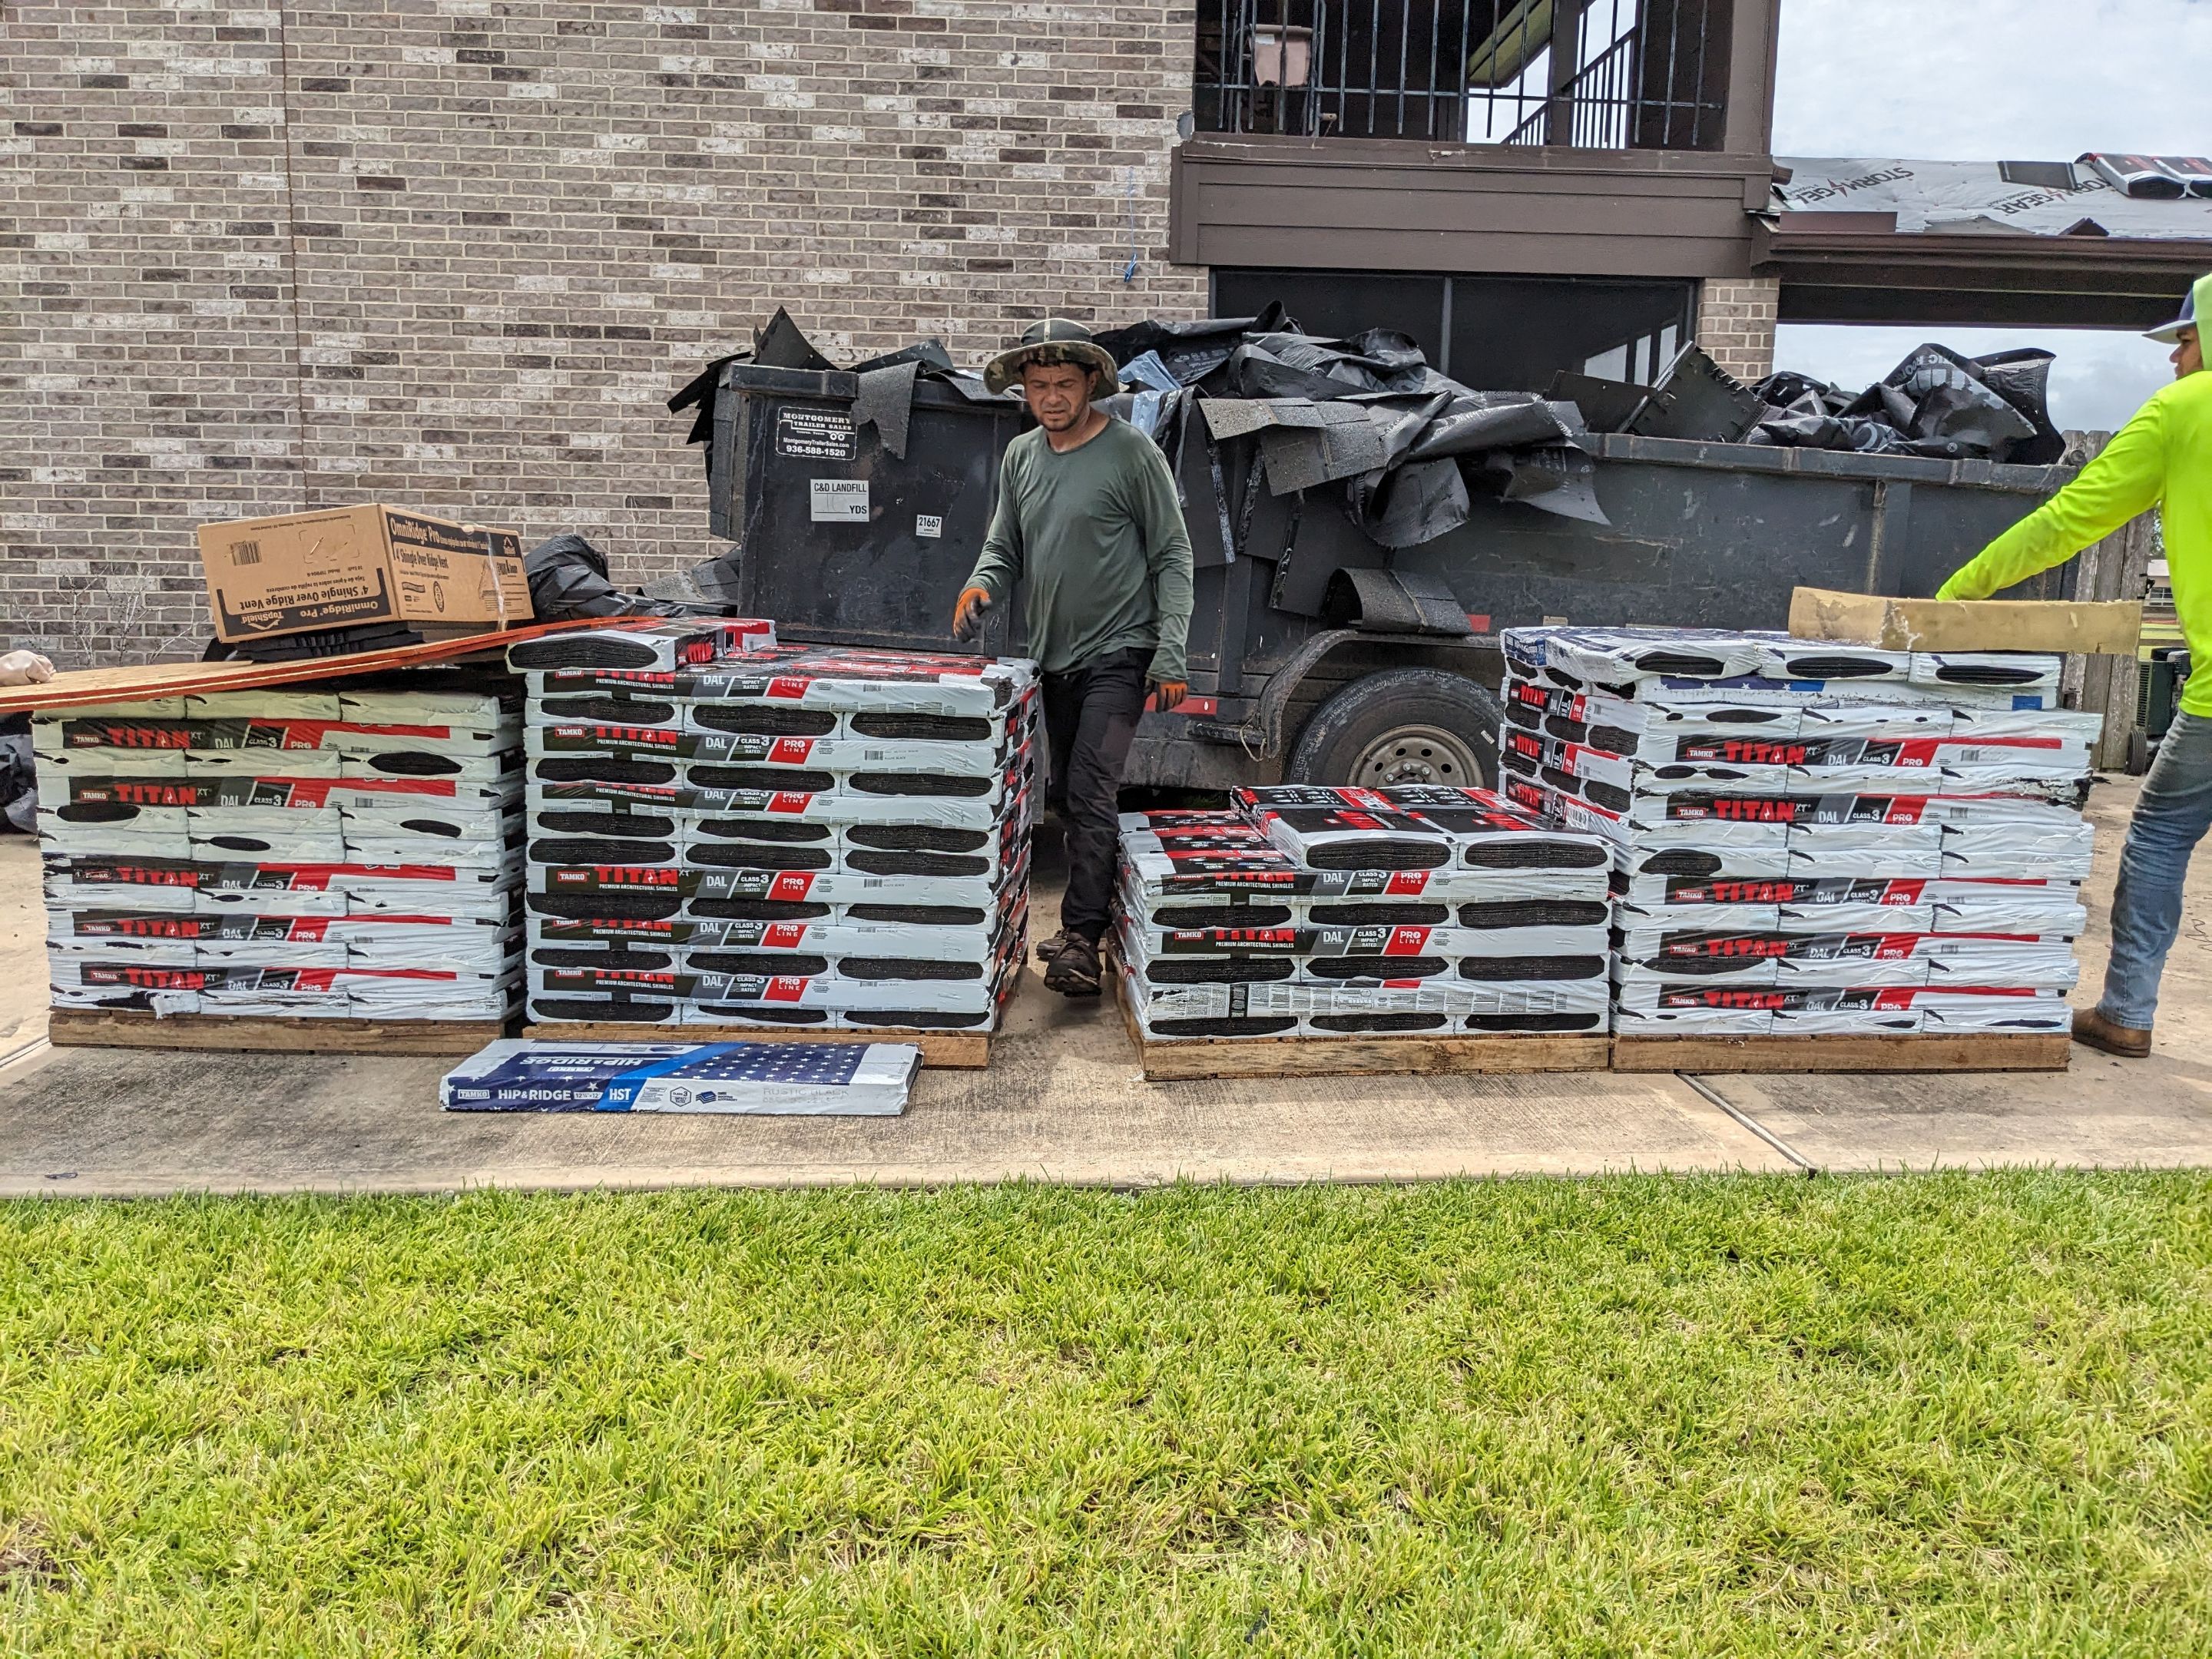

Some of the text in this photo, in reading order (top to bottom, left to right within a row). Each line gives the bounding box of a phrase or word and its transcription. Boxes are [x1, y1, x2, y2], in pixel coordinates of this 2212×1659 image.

[1841, 167, 1914, 190] STORM
[1993, 194, 2055, 214] GEAR
[783, 412, 851, 424] MONTGOMERY
[783, 437, 849, 448] MontgomeryTrailerSales.com
[786, 445, 846, 457] 936-588-1520
[814, 482, 867, 492] C&D LANDFILL
[849, 505, 867, 515] YDS
[919, 516, 941, 528] 21667
[428, 525, 440, 544] Pro
[296, 592, 320, 602] Over
[321, 586, 359, 598] Shingle
[266, 594, 295, 606] Ridge
[240, 601, 264, 611] Vent
[242, 611, 284, 624] TopShield
[300, 609, 318, 618] Pro
[618, 680, 652, 689] ARCHITECTURAL
[703, 675, 725, 685] DAL
[1521, 684, 1545, 707] TITAN
[107, 728, 190, 749] TITAN
[268, 737, 277, 747] 3
[705, 737, 727, 749] DAL
[760, 737, 770, 747] 3
[783, 740, 806, 748] PRO
[618, 740, 654, 749] ARCHITECTURAL
[1689, 750, 1714, 758] TAMKO
[1723, 742, 1806, 764] TITAN
[1882, 753, 1890, 764] 3
[115, 784, 197, 805] TITAN
[618, 789, 652, 800] ARCHITECTURAL
[273, 795, 282, 806] 3
[1714, 800, 1796, 822] TITAN
[1872, 810, 1879, 820] 3
[1818, 811, 1839, 823] DAL
[115, 866, 198, 888] TITAN
[594, 866, 679, 886] TITAN
[760, 875, 769, 883] 3
[1323, 873, 1344, 883] DAL
[276, 880, 284, 889] 3
[706, 876, 727, 888] DAL
[1711, 882, 1795, 902] TITAN
[1869, 889, 1878, 900] 3
[1889, 893, 1911, 902] PRO
[117, 919, 200, 938] TITAN
[700, 922, 721, 933] DAL
[1377, 928, 1386, 938] 3
[222, 929, 243, 939] DAL
[275, 928, 284, 939] 3
[1323, 931, 1344, 943] DAL
[1706, 939, 1788, 955] TITAN
[1862, 945, 1870, 956] 3
[1809, 947, 1829, 959] DAL
[92, 972, 118, 980] TAMKO
[125, 968, 204, 990] TITAN
[702, 975, 724, 987] DAL
[618, 980, 652, 988] ARCHITECTURAL
[1704, 992, 1785, 1010] TITAN
[1859, 999, 1868, 1010] 3
[460, 1090, 488, 1098] TAMKO
[608, 1088, 632, 1101] HST
